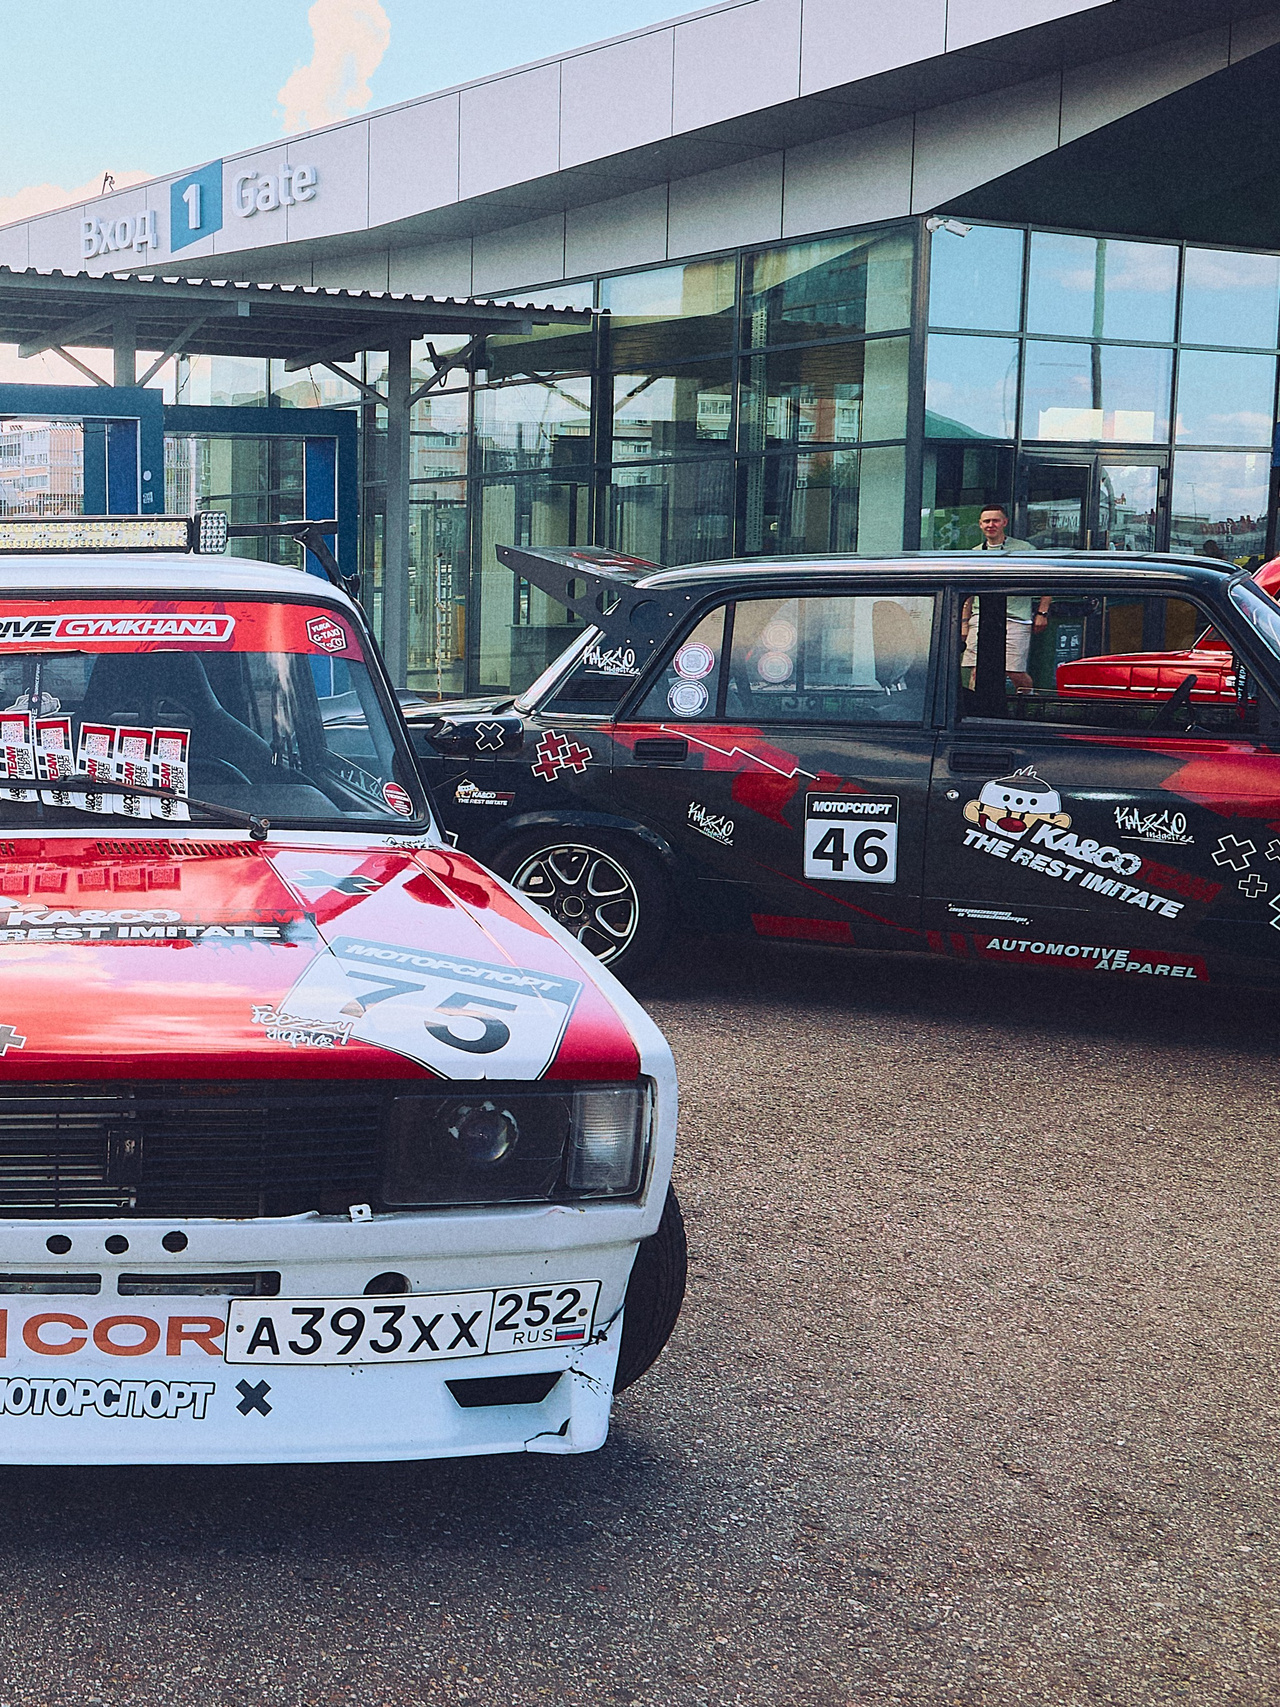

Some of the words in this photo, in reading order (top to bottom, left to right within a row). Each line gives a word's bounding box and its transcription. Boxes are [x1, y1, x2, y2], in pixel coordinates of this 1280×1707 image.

[80, 209, 158, 260] Вход
[181, 183, 202, 230] 1
[231, 163, 318, 218] Gate
[64, 618, 218, 638] GYMKHANA
[812, 800, 892, 815] МОТОРСПОРТ
[812, 827, 888, 875] 46
[1030, 823, 1142, 876] KA&CO
[963, 828, 1015, 859] THE
[1010, 846, 1084, 882] REST
[1079, 871, 1185, 919] IMITATE
[117, 925, 282, 938] IMITATE
[986, 938, 1131, 962] AUTOMOTIVE
[345, 943, 563, 992] МОТОРСПОРТ
[1094, 959, 1198, 979] APPAREL
[339, 970, 518, 1055] 75
[494, 1287, 584, 1332] 252
[512, 1327, 555, 1346] RUS
